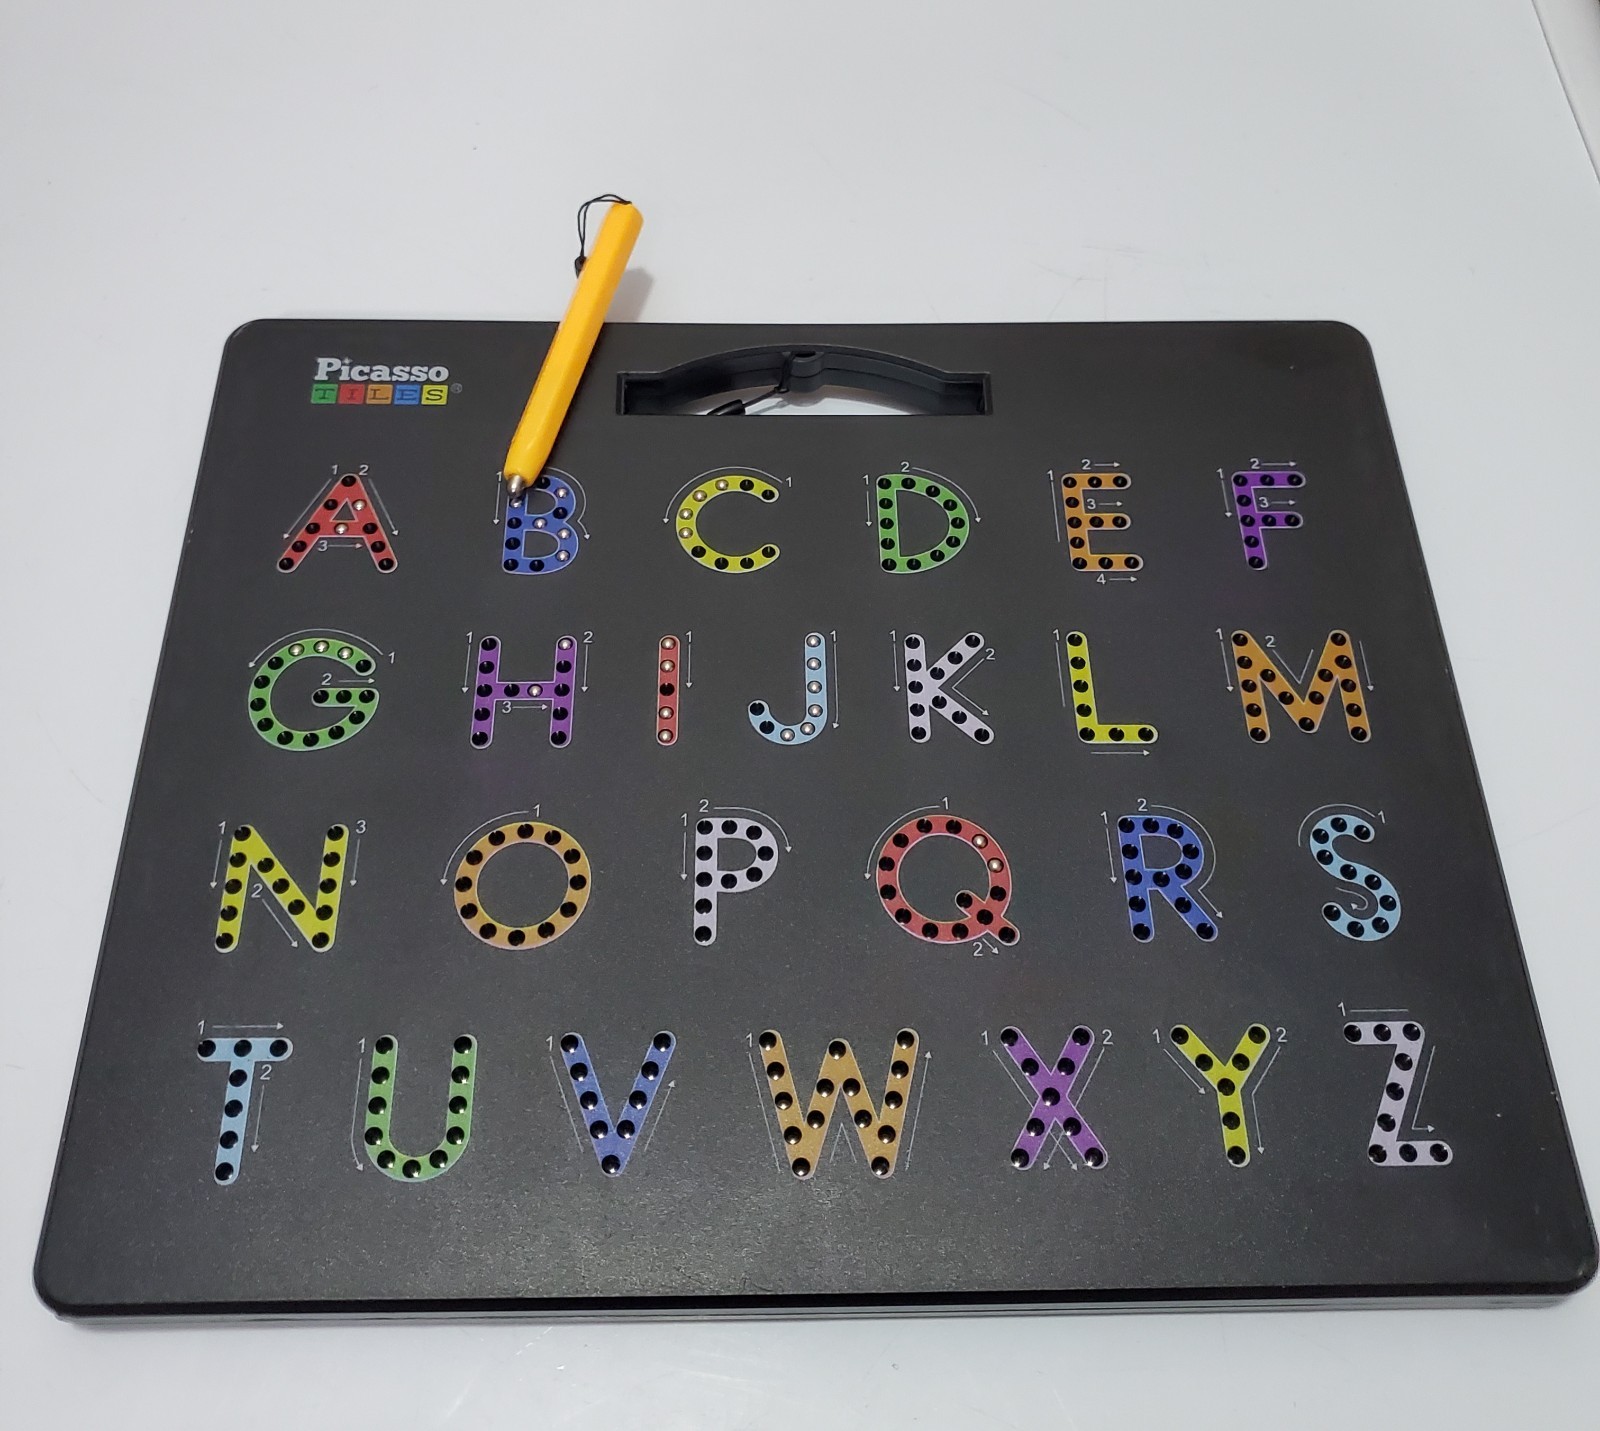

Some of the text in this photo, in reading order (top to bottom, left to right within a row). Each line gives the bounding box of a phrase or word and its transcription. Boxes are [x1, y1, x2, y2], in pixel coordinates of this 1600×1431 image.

[314, 357, 450, 382] Picasso
[311, 384, 448, 404] TILES
[331, 465, 339, 474] 1
[359, 464, 370, 475] 2
[900, 461, 910, 472] 2
[1081, 459, 1091, 470] 2
[1250, 458, 1260, 469] 2
[496, 471, 502, 481] 1
[1046, 470, 1053, 481] 1
[1216, 468, 1224, 479] 1
[785, 477, 792, 487] 1
[862, 475, 869, 485] 1
[1087, 498, 1096, 509] 3
[1258, 497, 1269, 508] 3
[276, 473, 398, 573] A
[675, 475, 780, 574] C
[876, 474, 970, 574] D
[1061, 473, 1143, 572] E
[1231, 470, 1306, 570] F
[317, 540, 328, 551] 3
[1096, 574, 1106, 585] 4
[466, 632, 473, 643] 1
[583, 632, 593, 643] 2
[686, 631, 692, 642] 1
[830, 630, 837, 641] 1
[890, 630, 896, 641] 1
[1053, 629, 1060, 640] 1
[1216, 628, 1223, 640] 1
[1265, 636, 1276, 647] 2
[388, 652, 395, 663] 1
[985, 649, 995, 660] 2
[321, 674, 332, 685] 2
[248, 638, 379, 751] G
[470, 636, 577, 749] H
[748, 632, 827, 745] J
[904, 632, 995, 745] K
[1065, 631, 1158, 744] L
[1231, 629, 1371, 743] M
[502, 701, 511, 713] 3
[699, 799, 709, 812] 2
[942, 797, 949, 810] 1
[1137, 798, 1148, 811] 2
[533, 804, 541, 817] 1
[680, 814, 688, 826] 1
[1101, 812, 1108, 824] 1
[1378, 811, 1386, 823] 1
[219, 821, 226, 834] 1
[356, 820, 366, 834] 3
[215, 814, 1401, 954] N O P Q R S
[251, 884, 263, 898] 2
[973, 942, 983, 956] 2
[1337, 1002, 1346, 1017] 1
[198, 1020, 205, 1034] 1
[746, 1032, 753, 1047] 1
[980, 1030, 990, 1045] 1
[1101, 1029, 1114, 1045] 2
[1153, 1029, 1161, 1043] 1
[1276, 1028, 1287, 1042] 2
[358, 1038, 365, 1053] 1
[546, 1036, 554, 1051] 1
[260, 1065, 272, 1080] 2
[197, 1020, 1453, 1186] T U V W X Y Z
